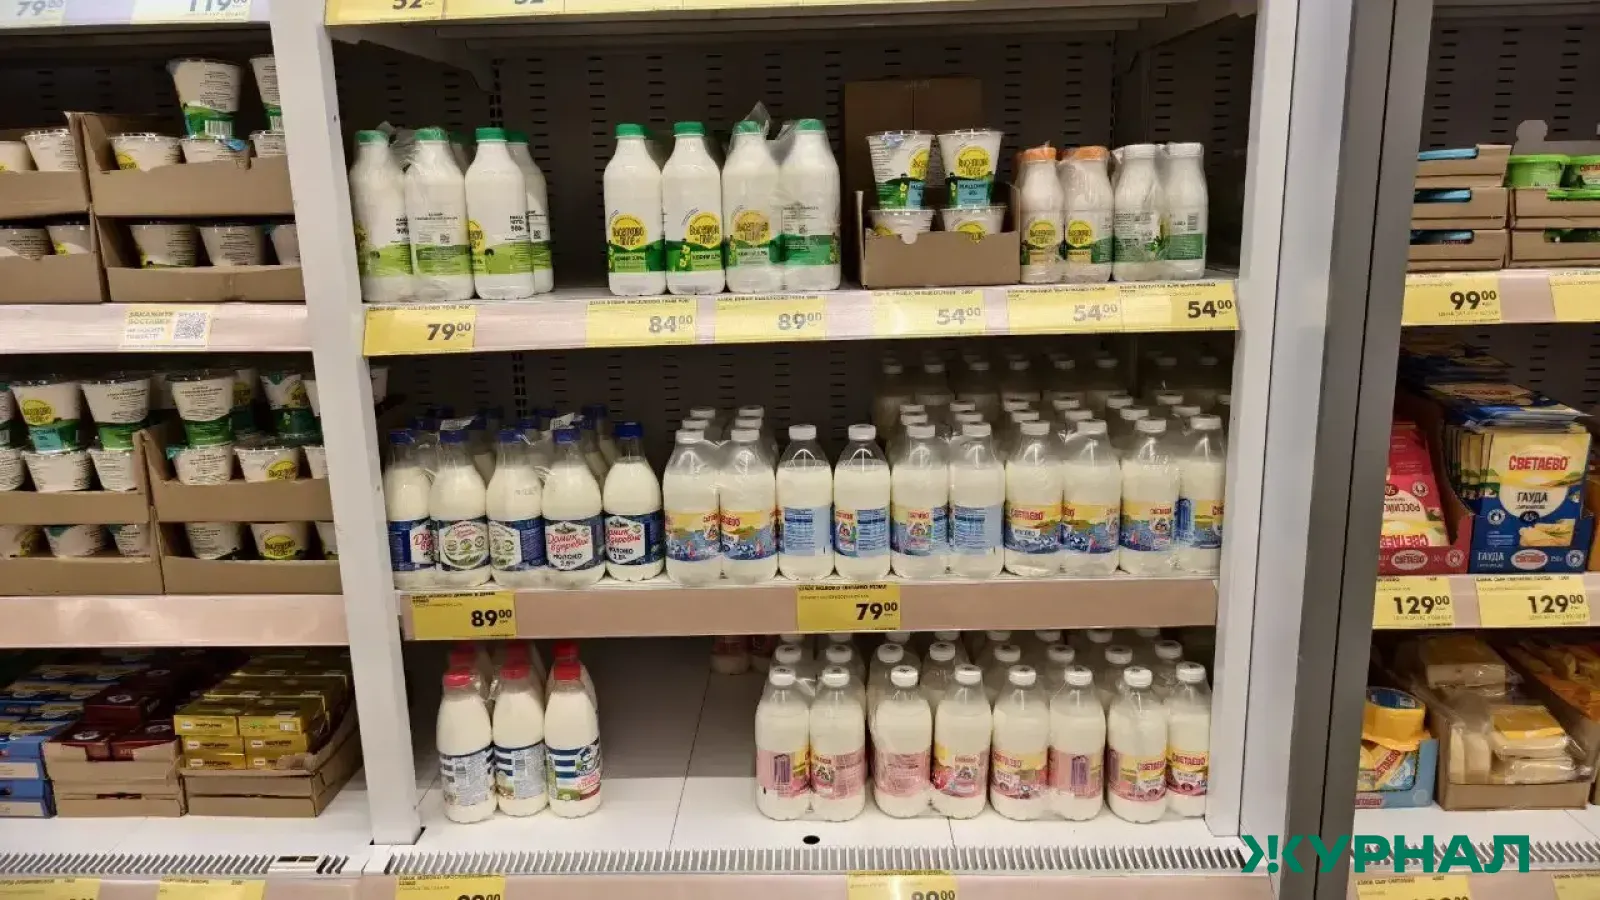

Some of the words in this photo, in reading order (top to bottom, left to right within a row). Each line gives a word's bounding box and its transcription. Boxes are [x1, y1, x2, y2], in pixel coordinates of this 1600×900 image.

[16, 1, 45, 16] 79
[1187, 300, 1217, 318] 54
[1217, 299, 1233, 310] 00
[1449, 291, 1481, 310] 99
[1481, 290, 1497, 301] 00
[777, 313, 807, 331] 89
[807, 312, 822, 322] 00
[937, 308, 966, 325] 54
[966, 307, 981, 317] 00
[1073, 304, 1102, 322] 54
[1102, 303, 1118, 313] 00
[427, 323, 456, 341] 79
[456, 322, 472, 332] 00
[648, 316, 677, 333] 84
[678, 315, 693, 326] 00
[1508, 455, 1568, 471] СВЕТАЕВО
[1516, 491, 1548, 503] ГАУДА
[1394, 555, 1425, 564] СВЕТАЕВО
[1477, 551, 1505, 563] ГАУДА
[855, 602, 883, 621] 79
[884, 602, 898, 612] 00
[1393, 596, 1435, 615] 129
[1435, 595, 1450, 606] 00
[1527, 594, 1569, 614] 129
[1569, 594, 1584, 604] 00
[470, 609, 498, 627] 89
[498, 609, 512, 618] 00
[1171, 753, 1206, 766] СВЕТАЕВО
